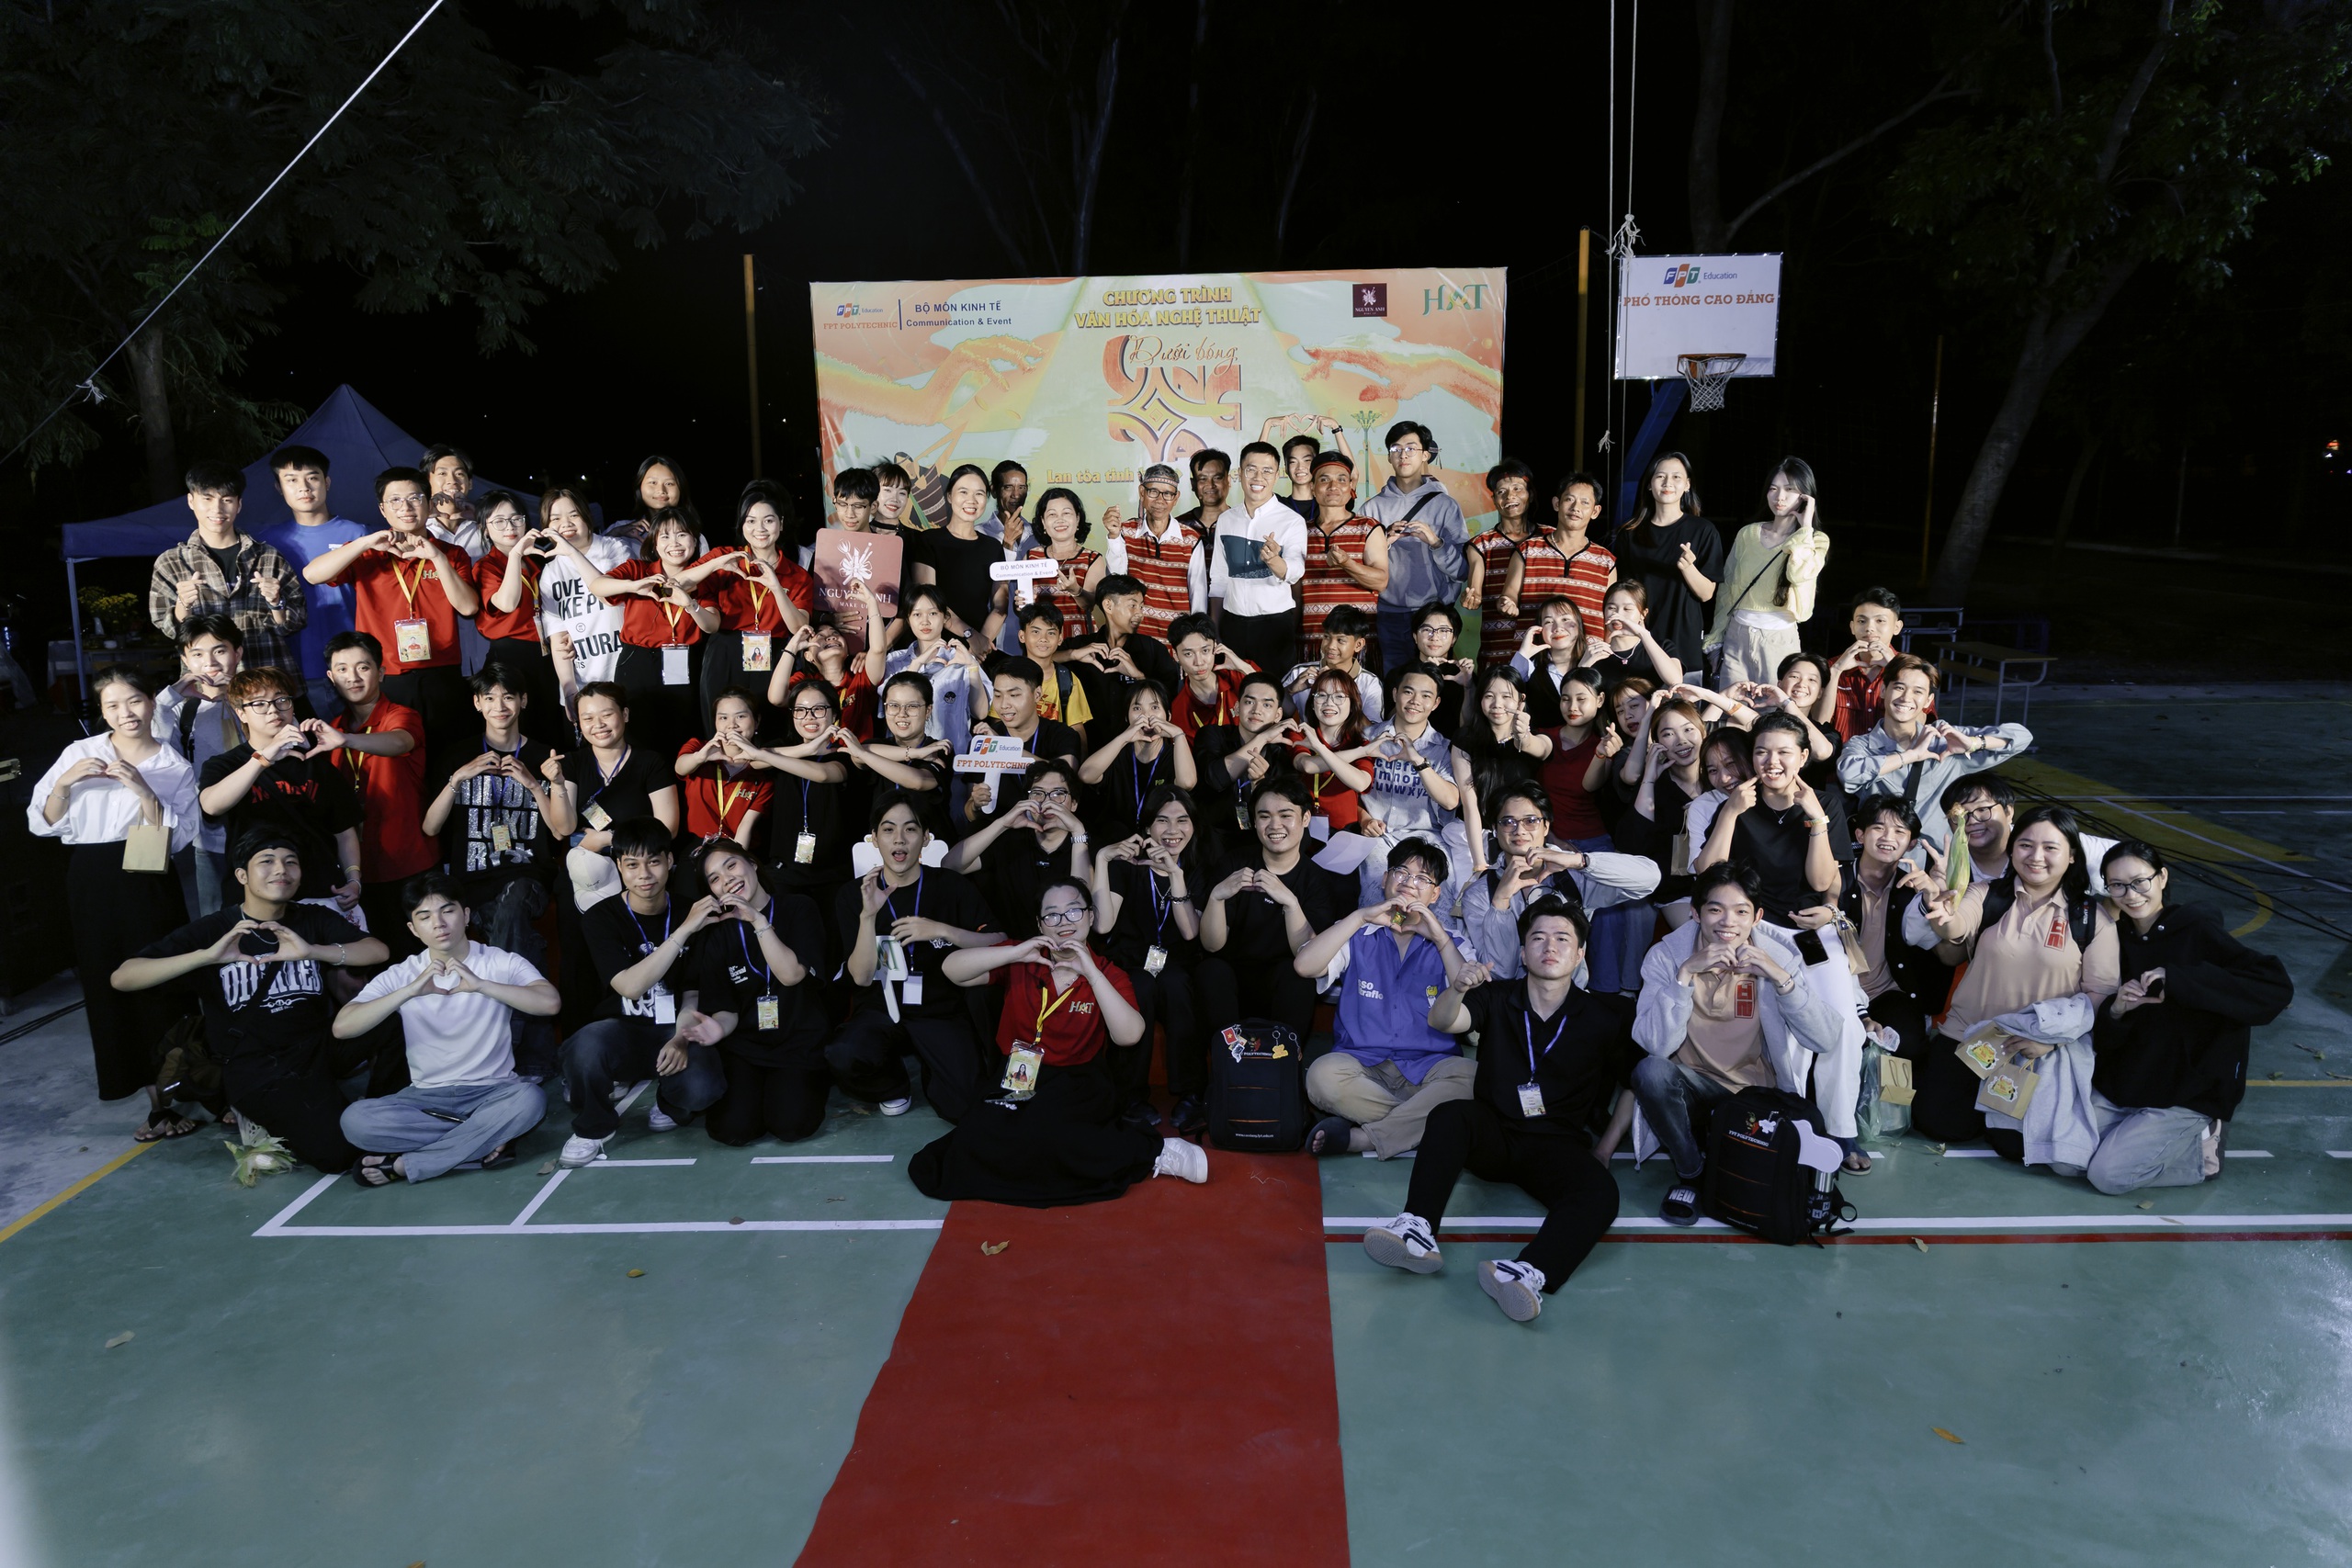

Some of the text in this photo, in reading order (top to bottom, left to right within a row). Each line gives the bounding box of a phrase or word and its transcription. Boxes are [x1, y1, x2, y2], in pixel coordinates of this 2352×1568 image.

[1664, 264, 1737, 288] FPT Education
[1102, 285, 1232, 306] CHƯƠNG TRÌNH
[1422, 284, 1488, 316] HAT
[1704, 295, 1733, 304] CAO
[836, 302, 861, 319] FPT
[915, 300, 1001, 314] BỘ MÔN KINH TẾ
[906, 319, 975, 328] Communication
[1074, 305, 1261, 328] VĂN HÓA NGHỆ THUẬT
[840, 321, 898, 330] POLYTECHNIC
[1195, 336, 1238, 376] bóng
[1046, 469, 1072, 484] Lan
[1076, 469, 1101, 483] tỏa
[552, 577, 584, 602] OVE
[875, 593, 891, 604] NH
[559, 596, 582, 621] IKE
[571, 630, 623, 660] TURA
[974, 738, 999, 755] FPT
[956, 760, 973, 768] FPT
[1069, 1001, 1095, 1014] HAT
